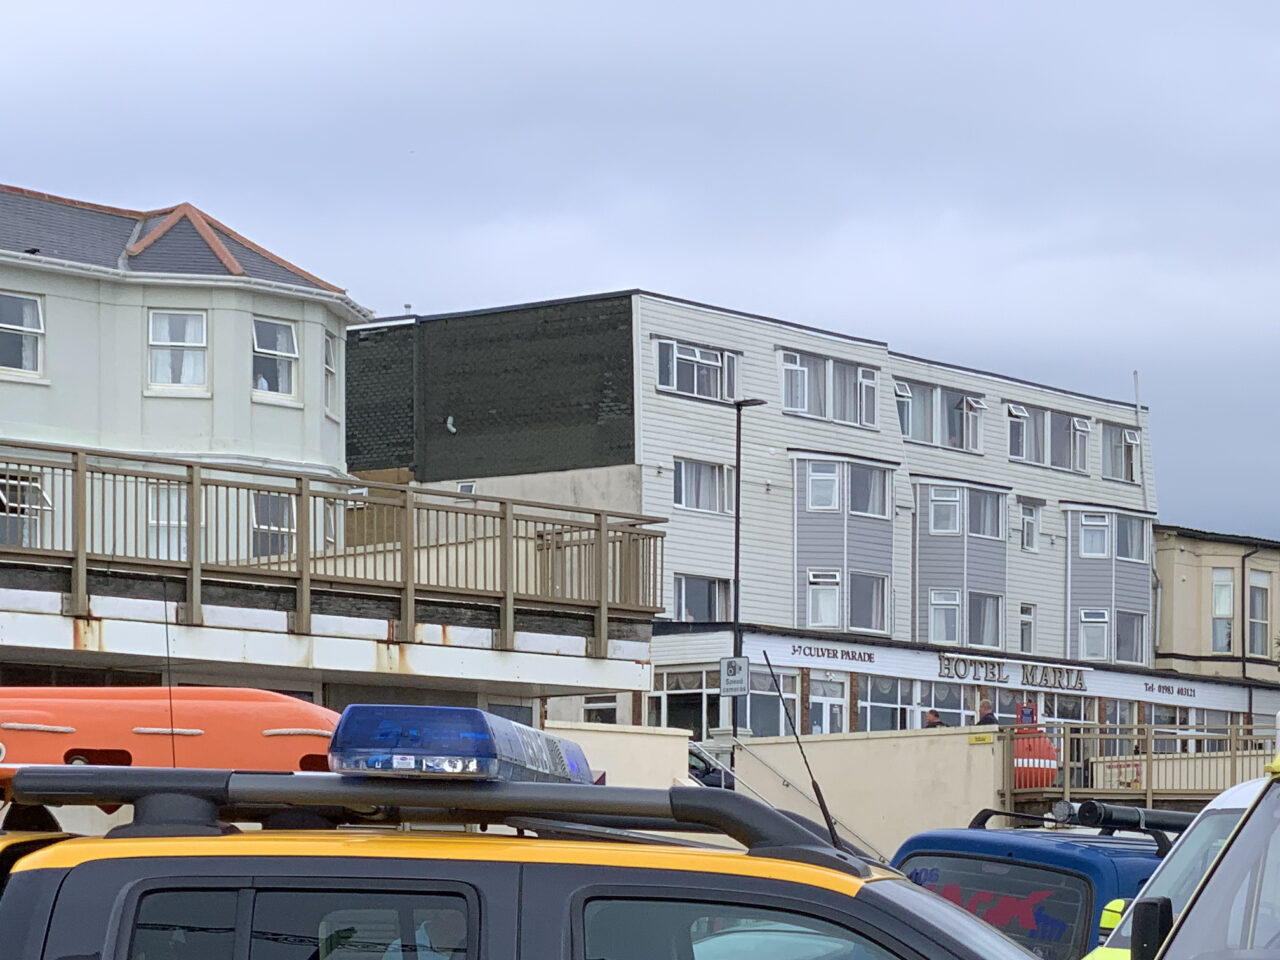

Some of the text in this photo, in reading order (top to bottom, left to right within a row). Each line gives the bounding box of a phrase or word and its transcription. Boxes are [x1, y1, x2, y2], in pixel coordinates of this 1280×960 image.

[791, 645, 875, 663] 3-7 CULVER PARADE
[938, 655, 1088, 691] HOTEL MARIA
